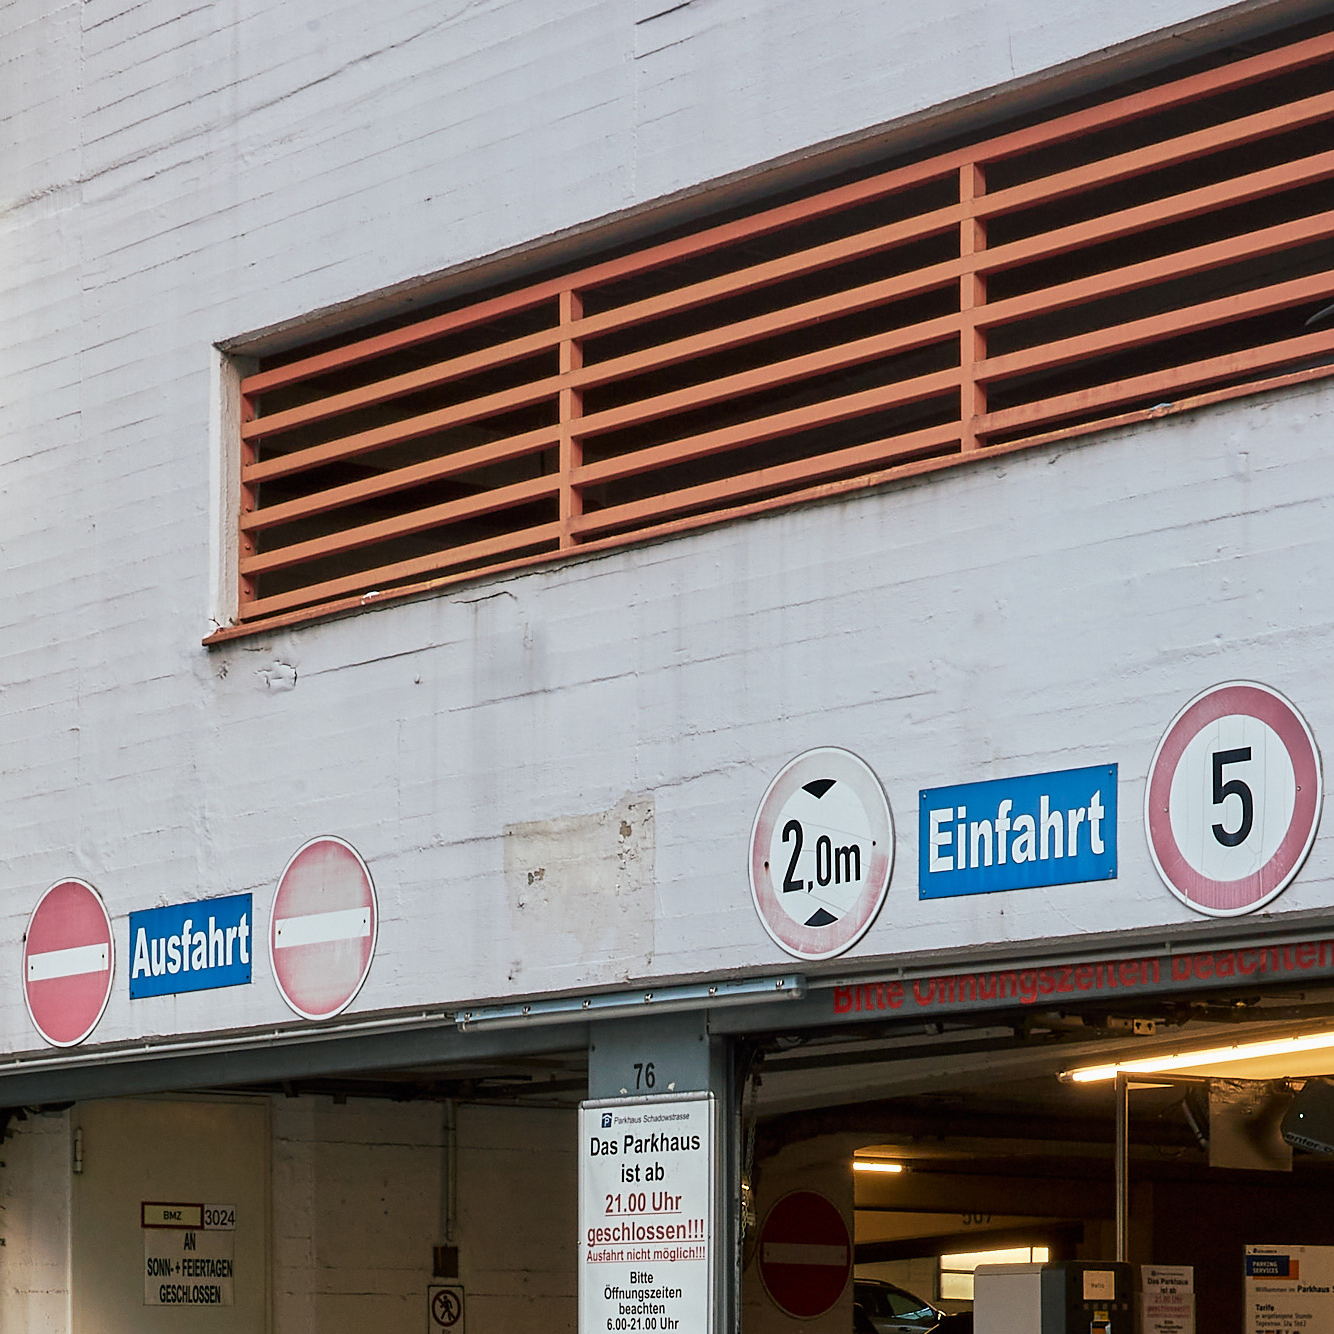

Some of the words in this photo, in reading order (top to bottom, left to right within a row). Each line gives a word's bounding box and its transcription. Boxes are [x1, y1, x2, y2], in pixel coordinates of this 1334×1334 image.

[1211, 746, 1254, 847] 5
[929, 789, 1105, 874] Einfahrt
[132, 913, 249, 980] Ausfahrt
[633, 1061, 656, 1090] 76
[613, 1117, 642, 1125] Parkhaus
[643, 1112, 690, 1123] Schadowstrasse
[590, 1136, 618, 1157] Das
[623, 1132, 701, 1155] Parkhaus
[621, 1163, 641, 1183] ist
[645, 1161, 665, 1182] ab
[605, 1192, 647, 1213] 21.00
[652, 1191, 682, 1211] Uhr
[163, 1210, 182, 1221] BMZ
[205, 1209, 235, 1226] 3024
[183, 1232, 196, 1250] AN
[587, 1218, 705, 1248] geschlossen!!!
[587, 1249, 625, 1262] Ausfahrt
[626, 1247, 651, 1260] nicht
[653, 1245, 706, 1263] möglich!!!
[182, 1258, 233, 1278] FEIERTAGEN
[630, 1271, 654, 1284] Bitte
[159, 1284, 221, 1304] GESCHLOSSEN
[604, 1284, 682, 1303] Öffnungszeiten
[1297, 1285, 1330, 1294] Parkhaus
[618, 1302, 666, 1315] beachten
[1255, 1303, 1275, 1312] Tarife
[606, 1317, 657, 1331] 6.00-21.00
[660, 1317, 679, 1330] Uhr
